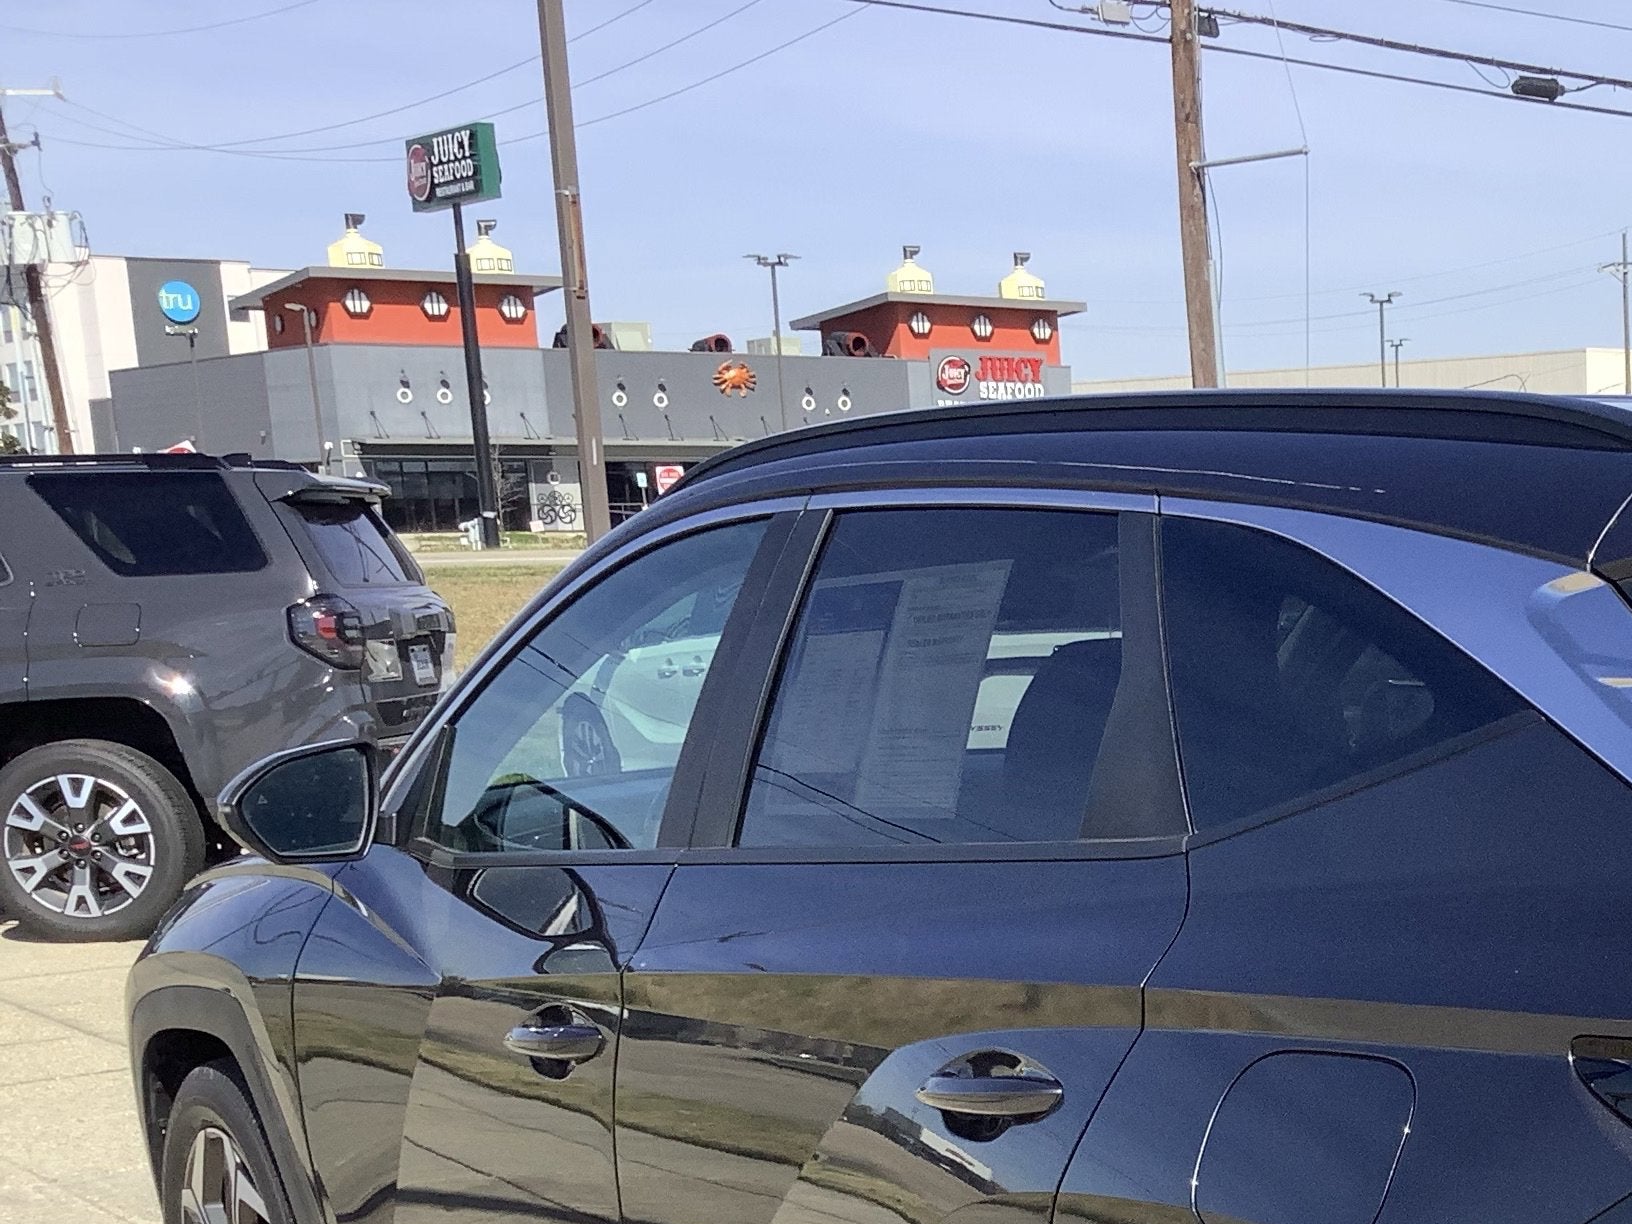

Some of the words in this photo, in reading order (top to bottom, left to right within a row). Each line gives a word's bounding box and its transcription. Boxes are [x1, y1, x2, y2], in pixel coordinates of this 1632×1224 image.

[431, 130, 470, 165] JUICY
[432, 158, 475, 184] SEAFOOD
[159, 288, 193, 310] tru
[975, 356, 1043, 384] JUICY
[979, 381, 1045, 400] SEAFOOD
